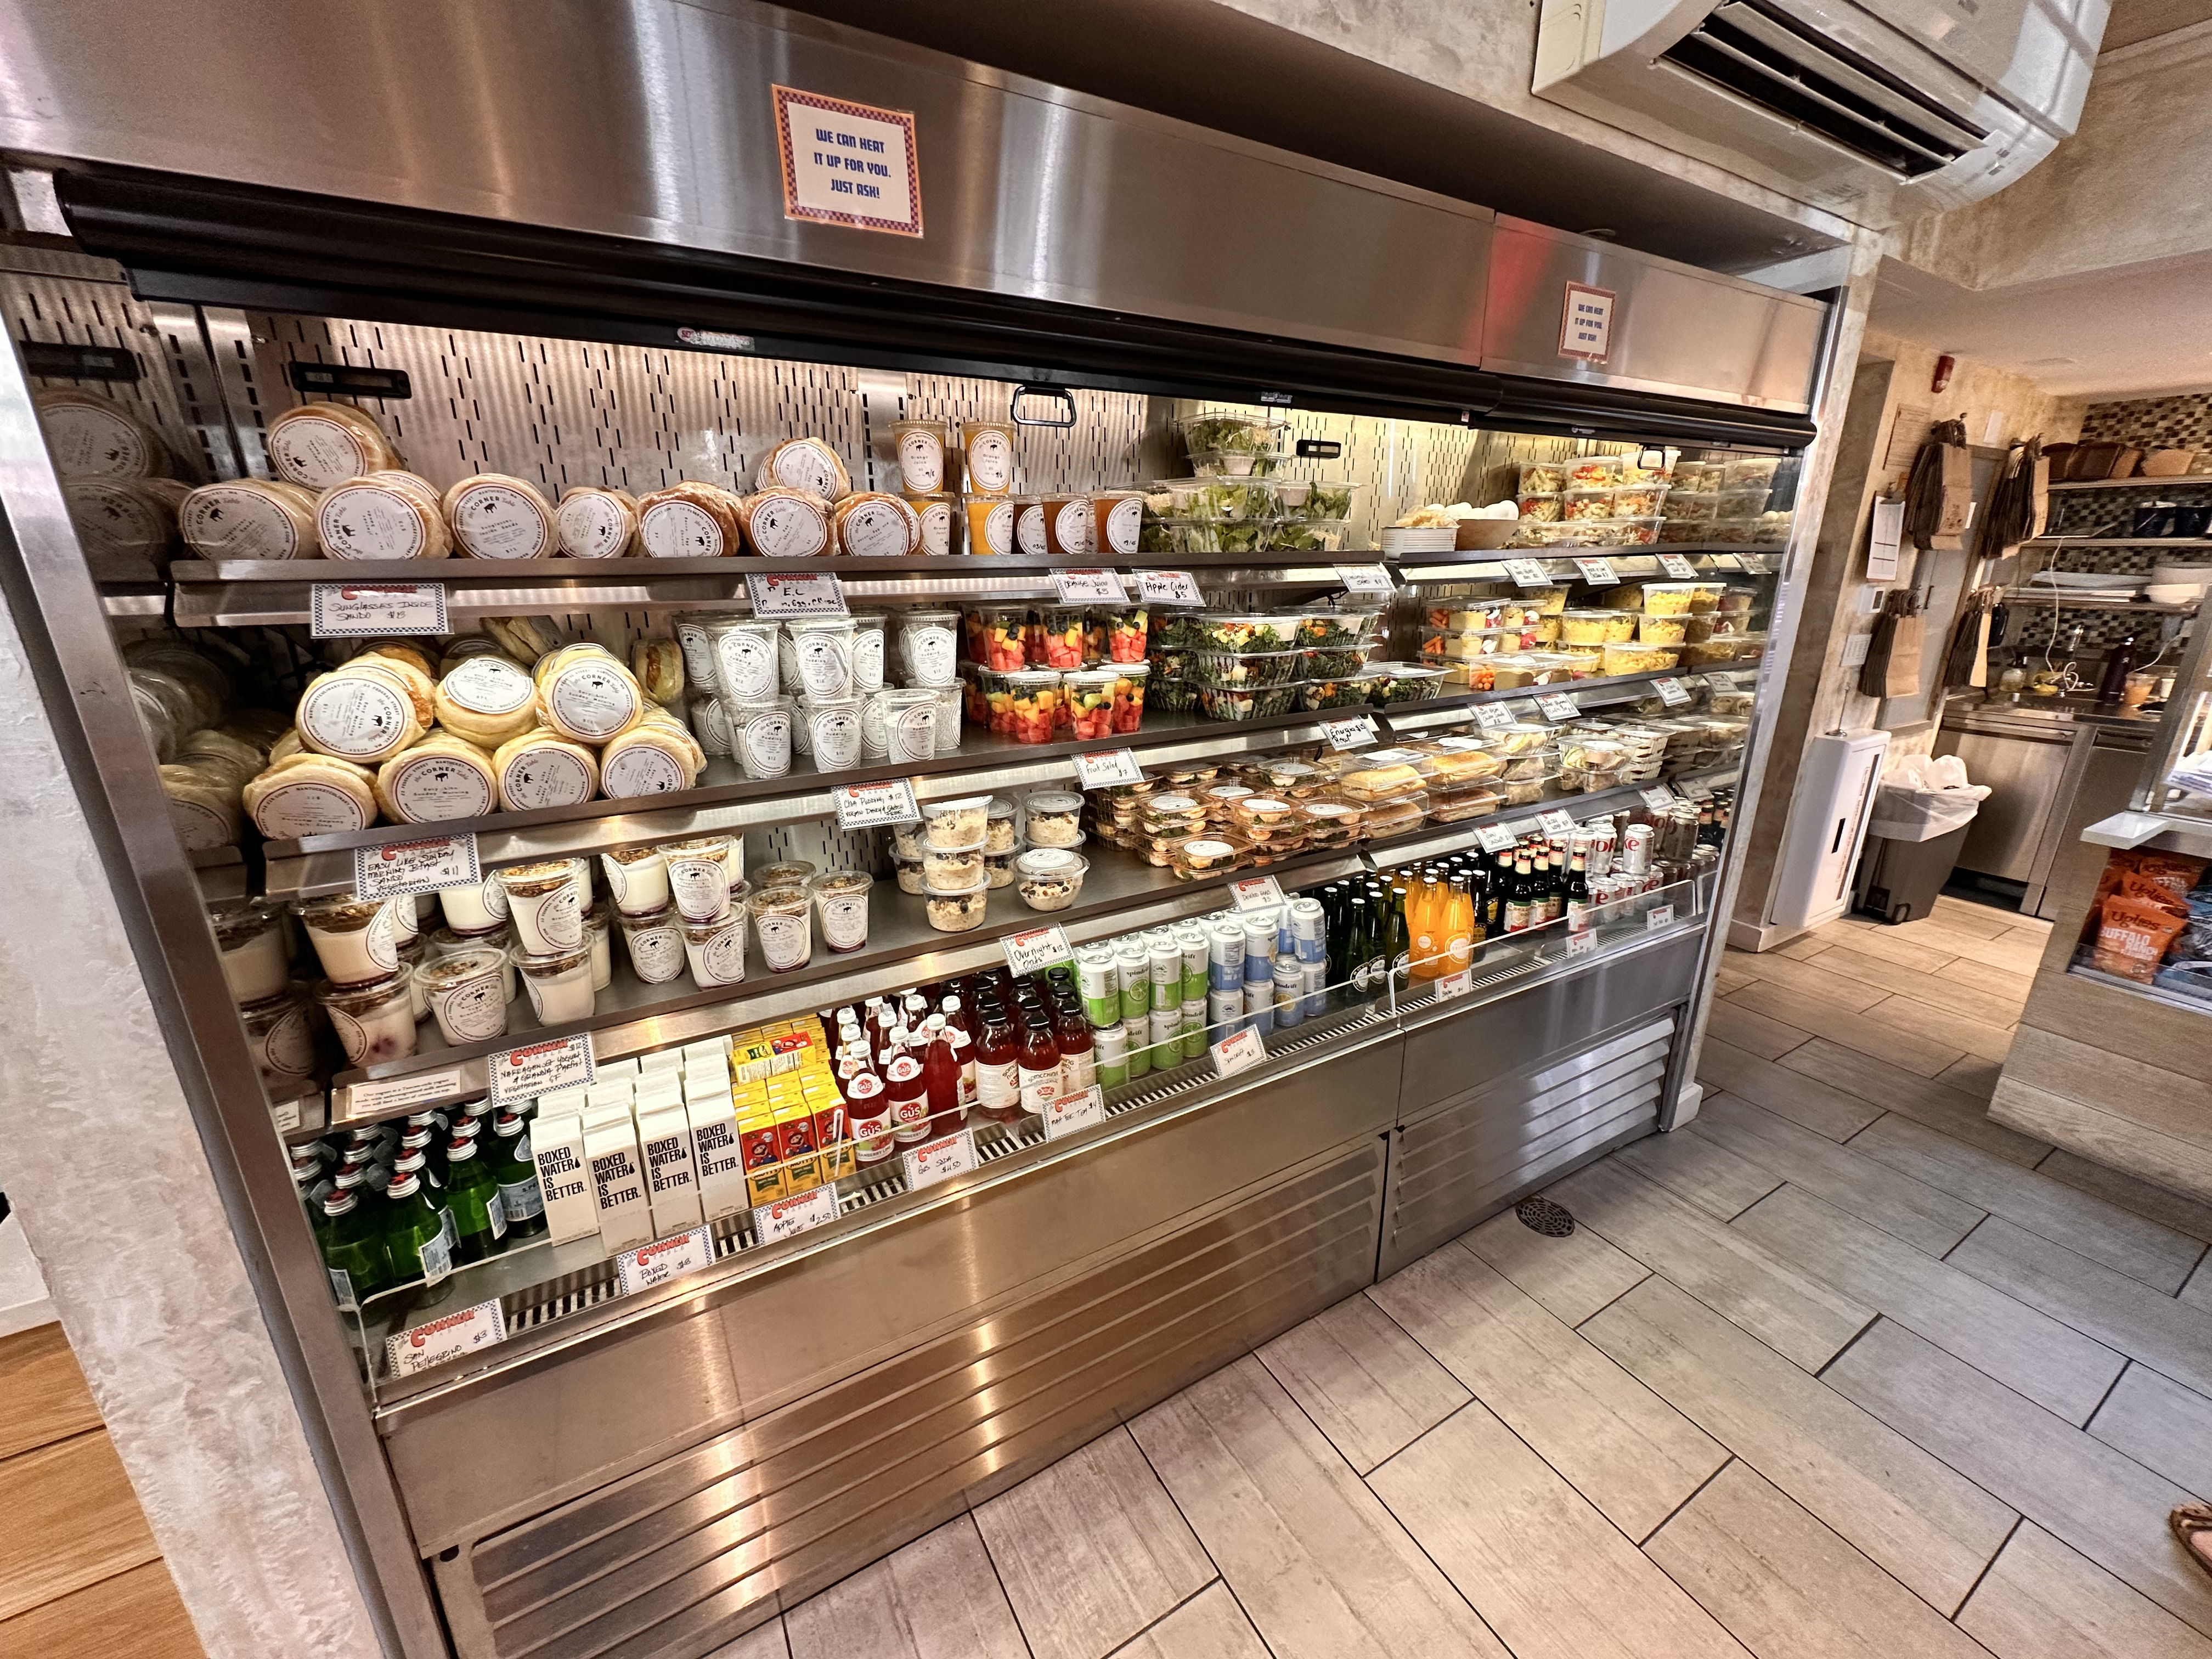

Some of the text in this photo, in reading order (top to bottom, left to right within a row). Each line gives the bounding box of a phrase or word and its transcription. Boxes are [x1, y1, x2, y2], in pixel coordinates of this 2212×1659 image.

[816, 128, 884, 154] WE CAN HEAT
[814, 152, 891, 178] IT UP FOR YOU.
[831, 179, 880, 199] JUST ASK!
[471, 496, 500, 511] CORNER
[581, 674, 611, 685] CORNER
[421, 766, 456, 776] CORNER
[516, 765, 527, 792] CORNER
[397, 857, 416, 867] LIKE
[419, 850, 454, 862] SUNDAY
[2112, 911, 2160, 930] Uglies
[1014, 941, 1052, 961] Overnight
[461, 985, 489, 1001] CORNER
[510, 1041, 568, 1066] CORNER
[696, 1123, 726, 1141] BOXED
[647, 1137, 678, 1156] BOXED
[698, 1135, 730, 1153] WATER
[538, 1147, 571, 1165] BOXED
[592, 1152, 625, 1172] BOXED
[649, 1150, 681, 1168] WATER
[700, 1152, 710, 1164] IS
[540, 1159, 575, 1177] WATER
[595, 1165, 629, 1184] WATER
[651, 1167, 661, 1180] IS
[543, 1177, 554, 1189] IS
[597, 1184, 608, 1197] IS
[637, 1234, 690, 1266] CORNER
[410, 1310, 475, 1347] CORNER
[404, 1349, 424, 1364] SAN
